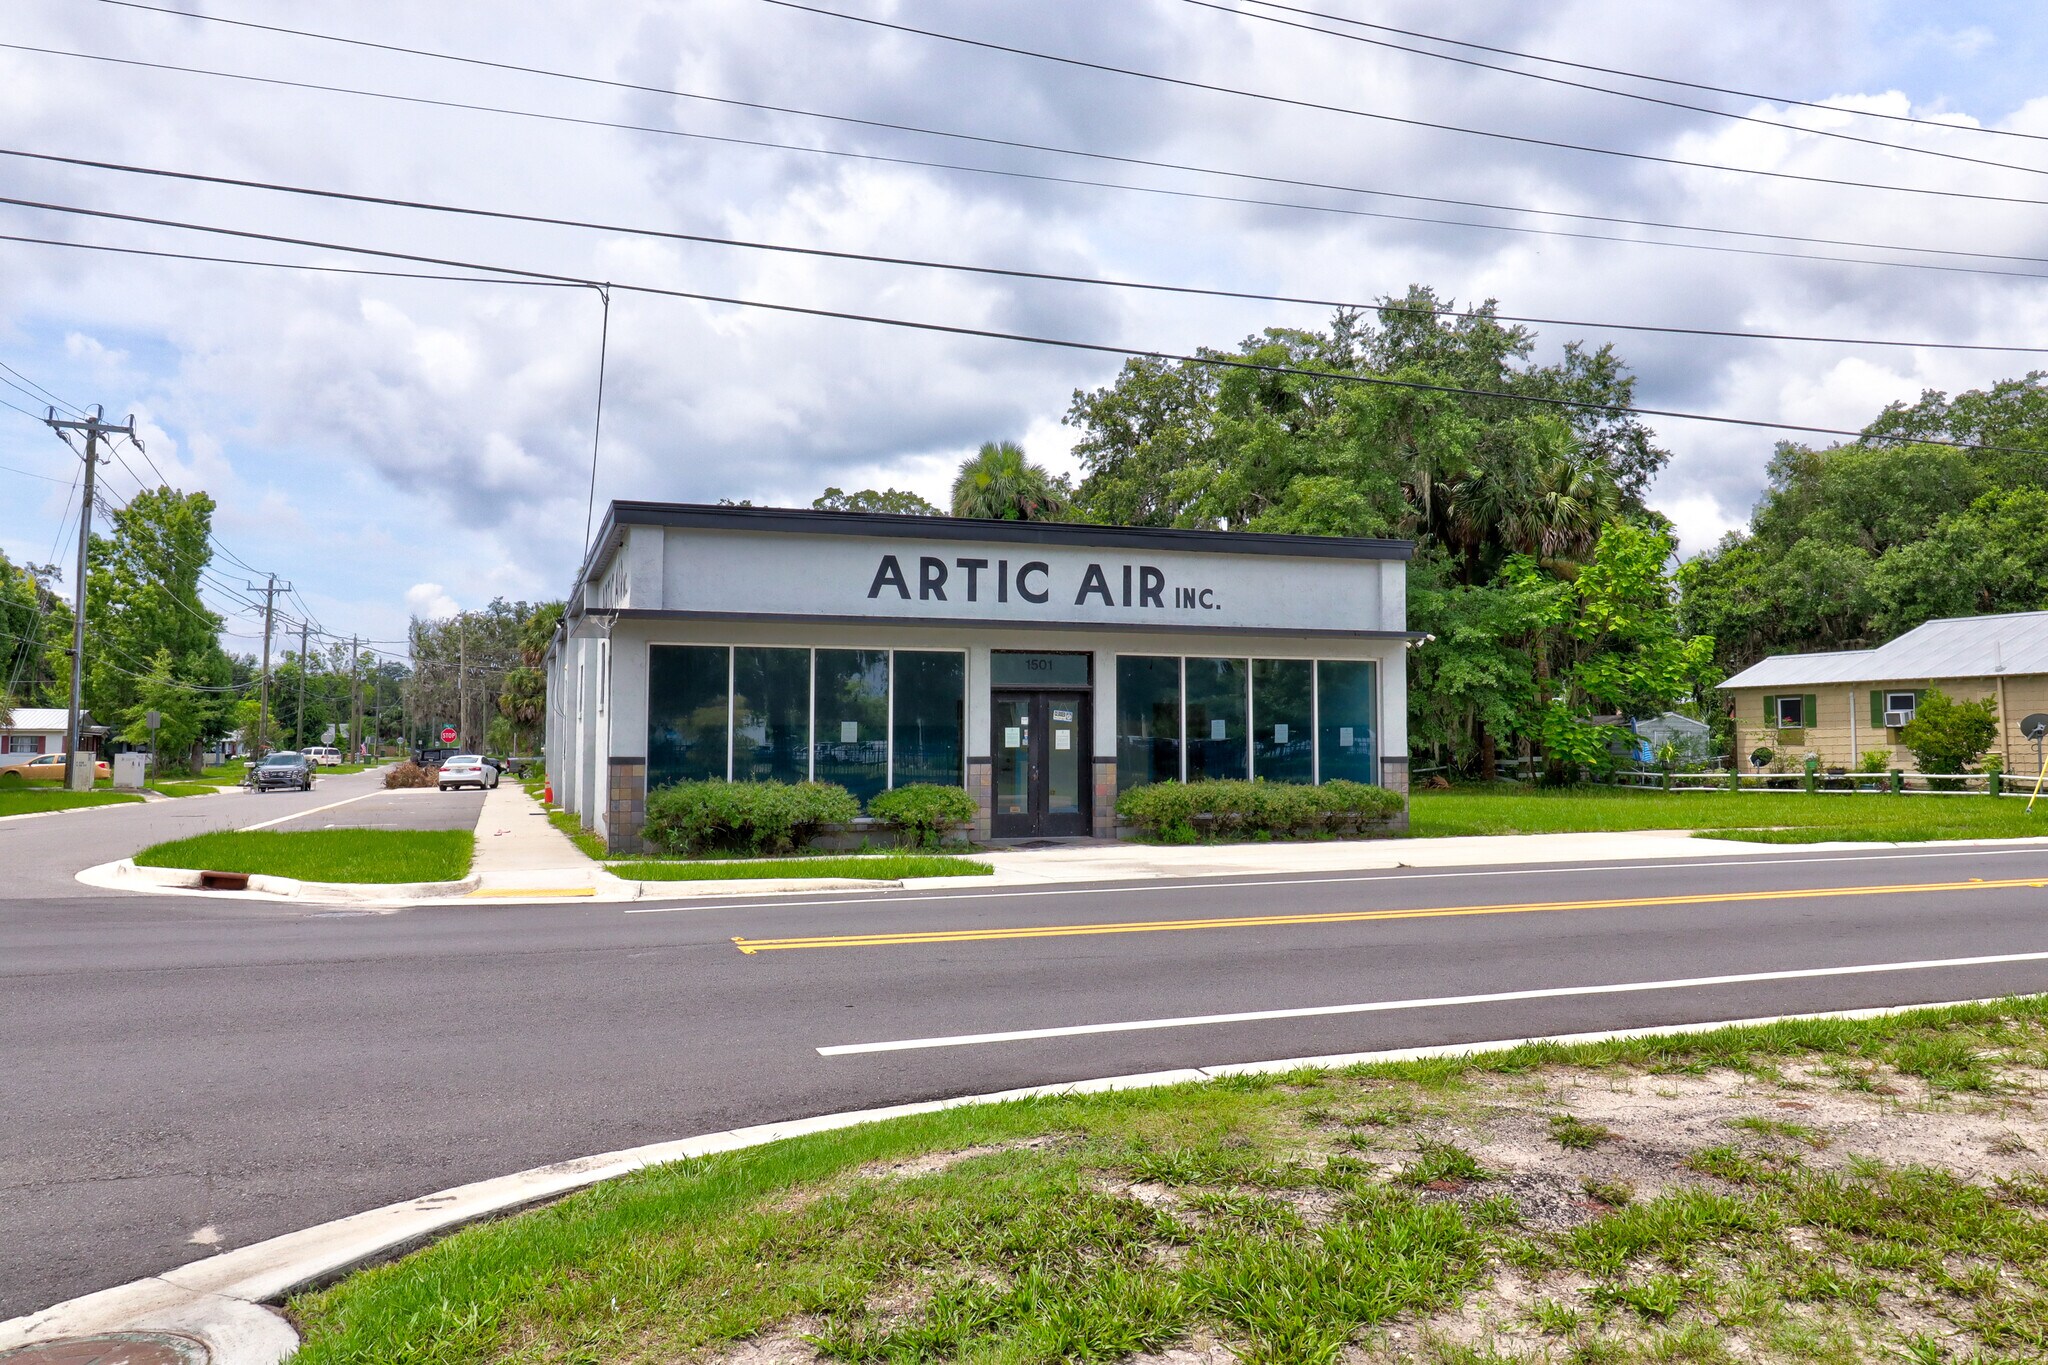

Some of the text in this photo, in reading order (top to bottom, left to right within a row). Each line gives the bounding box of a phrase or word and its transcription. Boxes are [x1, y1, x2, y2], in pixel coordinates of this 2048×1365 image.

[867, 555, 1221, 610] ARTIC AIR INC.
[1025, 659, 1053, 671] 1501
